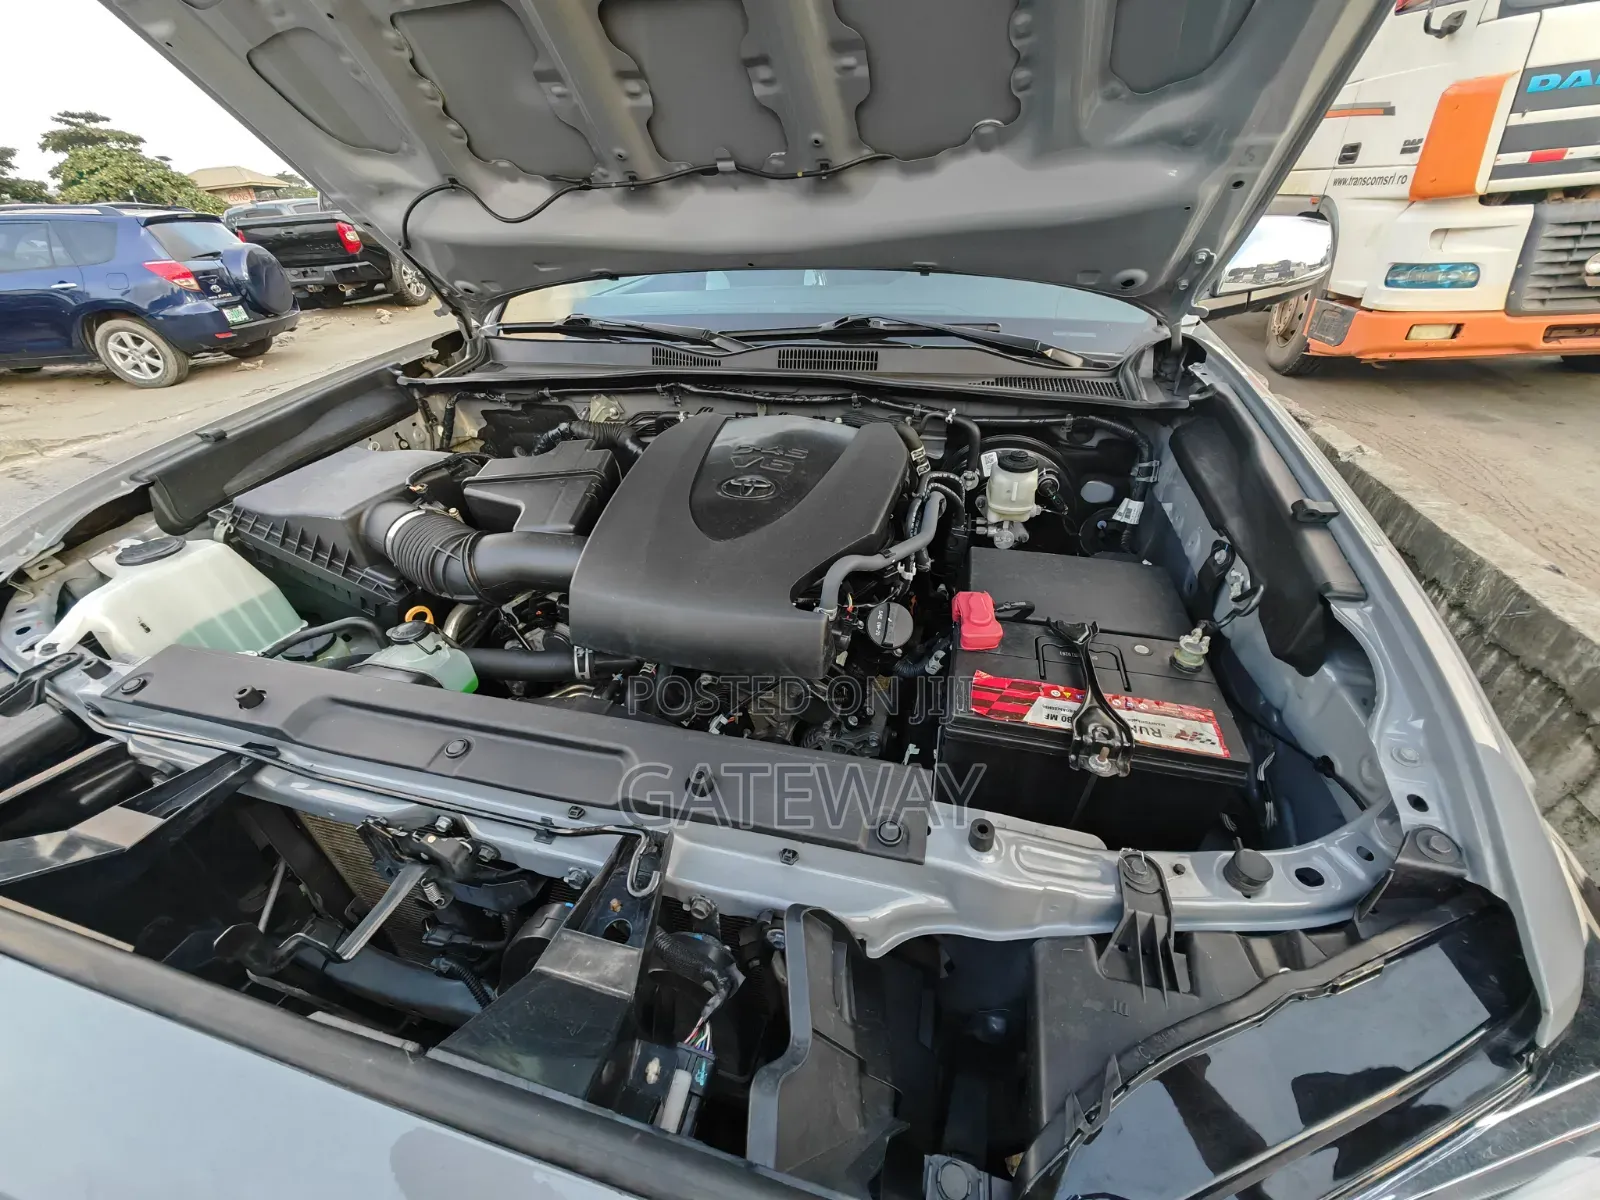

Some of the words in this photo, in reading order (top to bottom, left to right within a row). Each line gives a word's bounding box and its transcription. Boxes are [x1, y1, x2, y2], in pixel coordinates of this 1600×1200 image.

[1527, 69, 1600, 93] DA
[1333, 173, 1408, 187] www.transcomsrl.ro
[730, 456, 795, 473] V6
